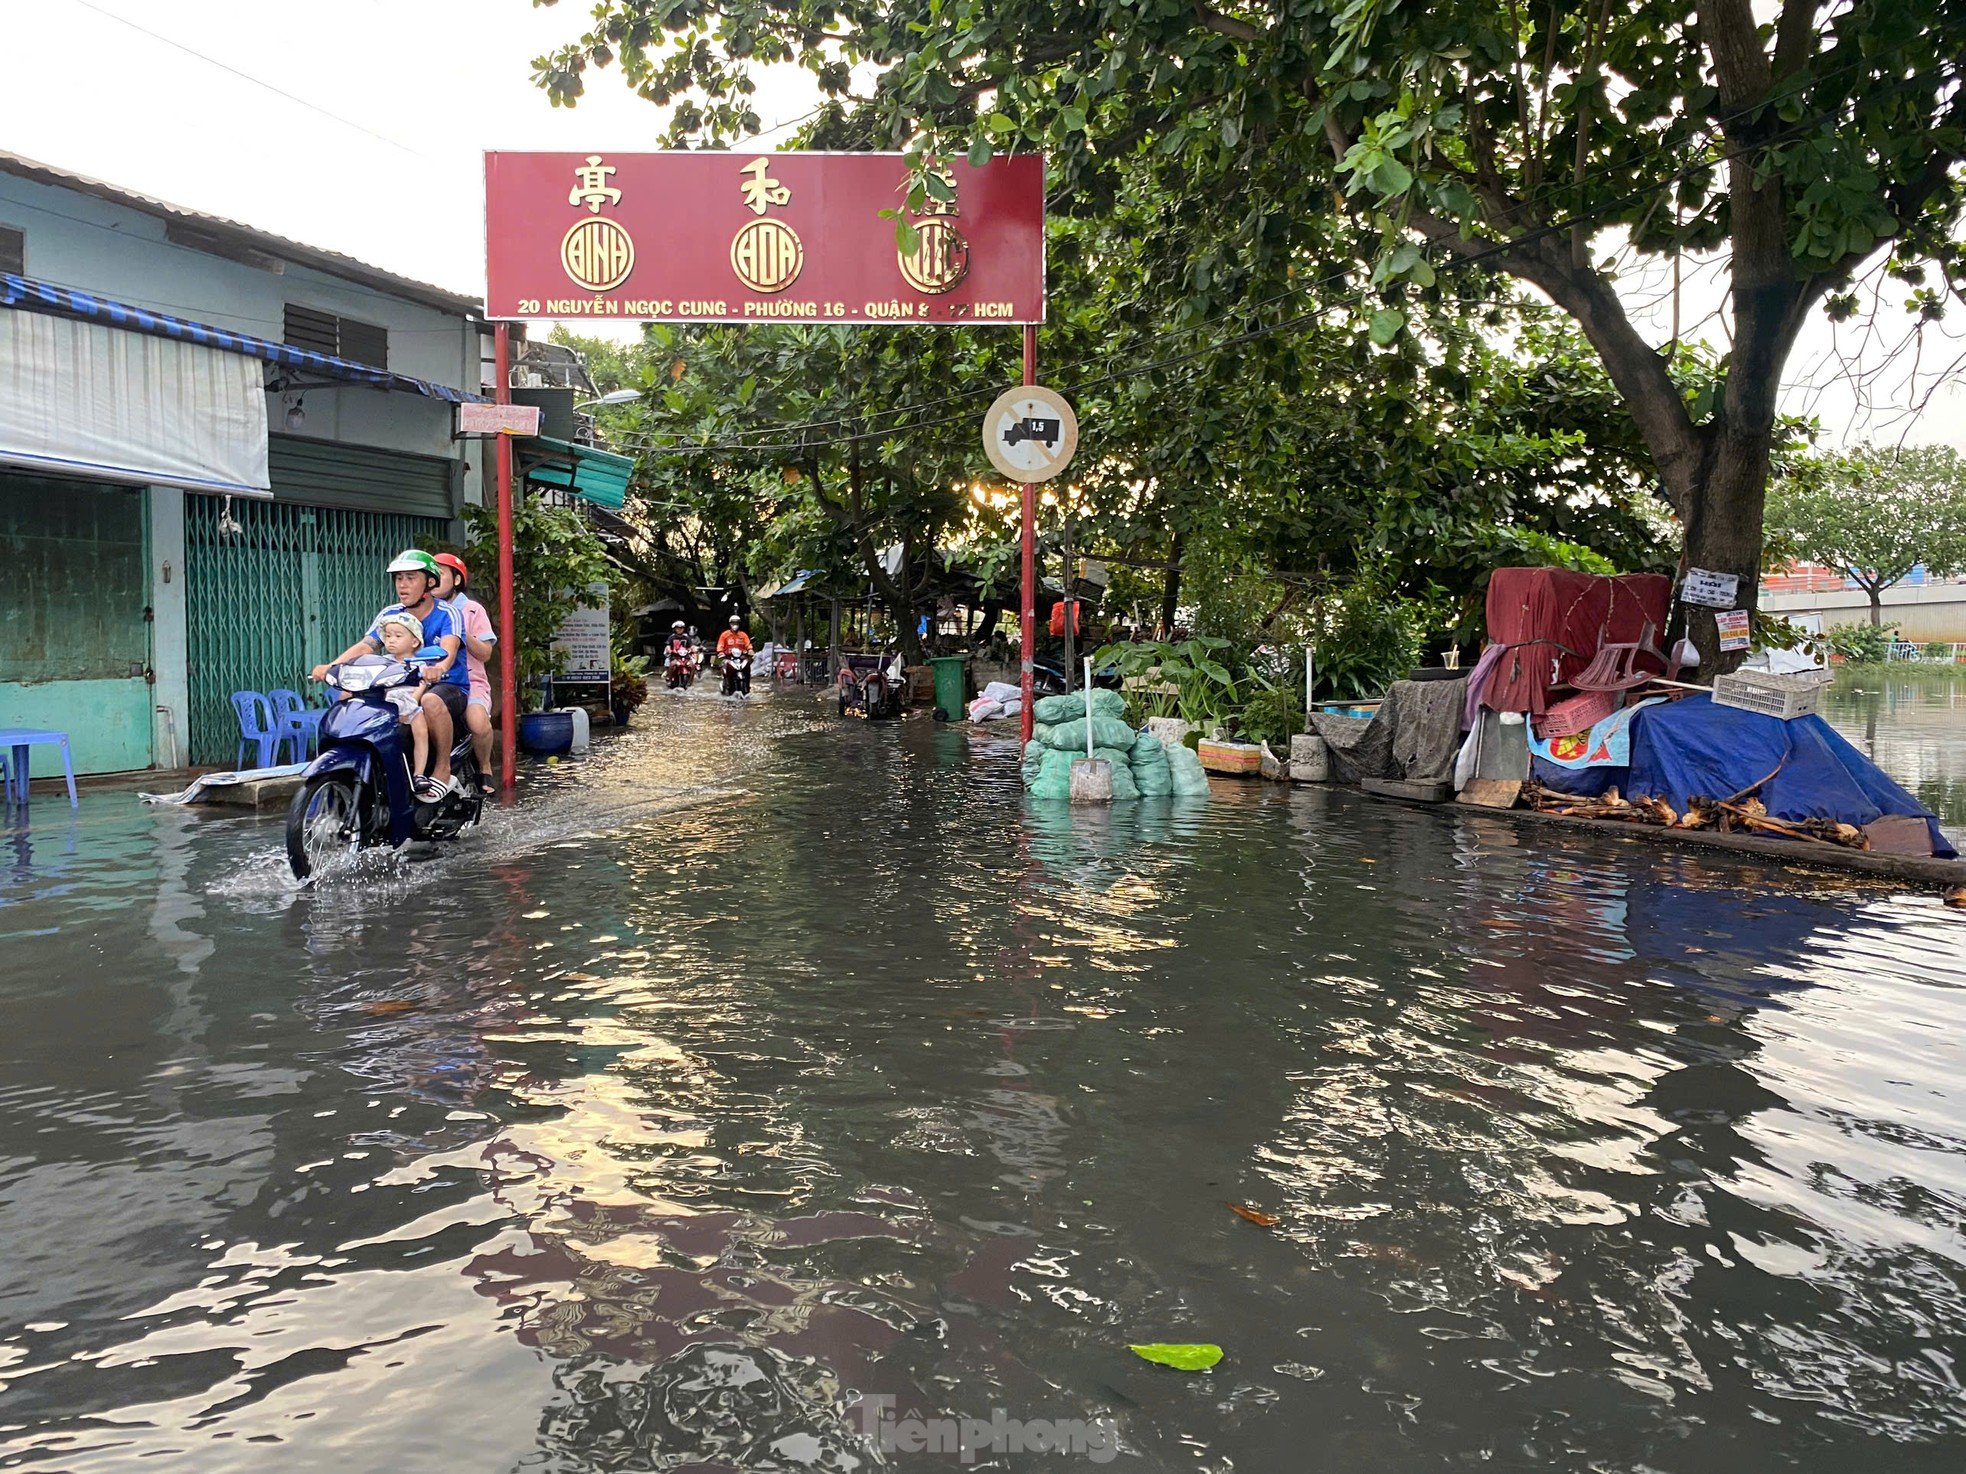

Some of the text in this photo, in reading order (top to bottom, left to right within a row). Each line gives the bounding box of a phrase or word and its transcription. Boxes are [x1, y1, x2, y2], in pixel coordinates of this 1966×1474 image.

[568, 155, 792, 215] 亭 和
[517, 299, 540, 314] 20
[546, 295, 618, 315] NGUYỄN
[624, 301, 673, 319] NGỌC
[678, 301, 727, 316] CUNG
[744, 299, 817, 317] PHƯỜNG
[823, 302, 846, 317] 16
[864, 299, 914, 320] QUẬN
